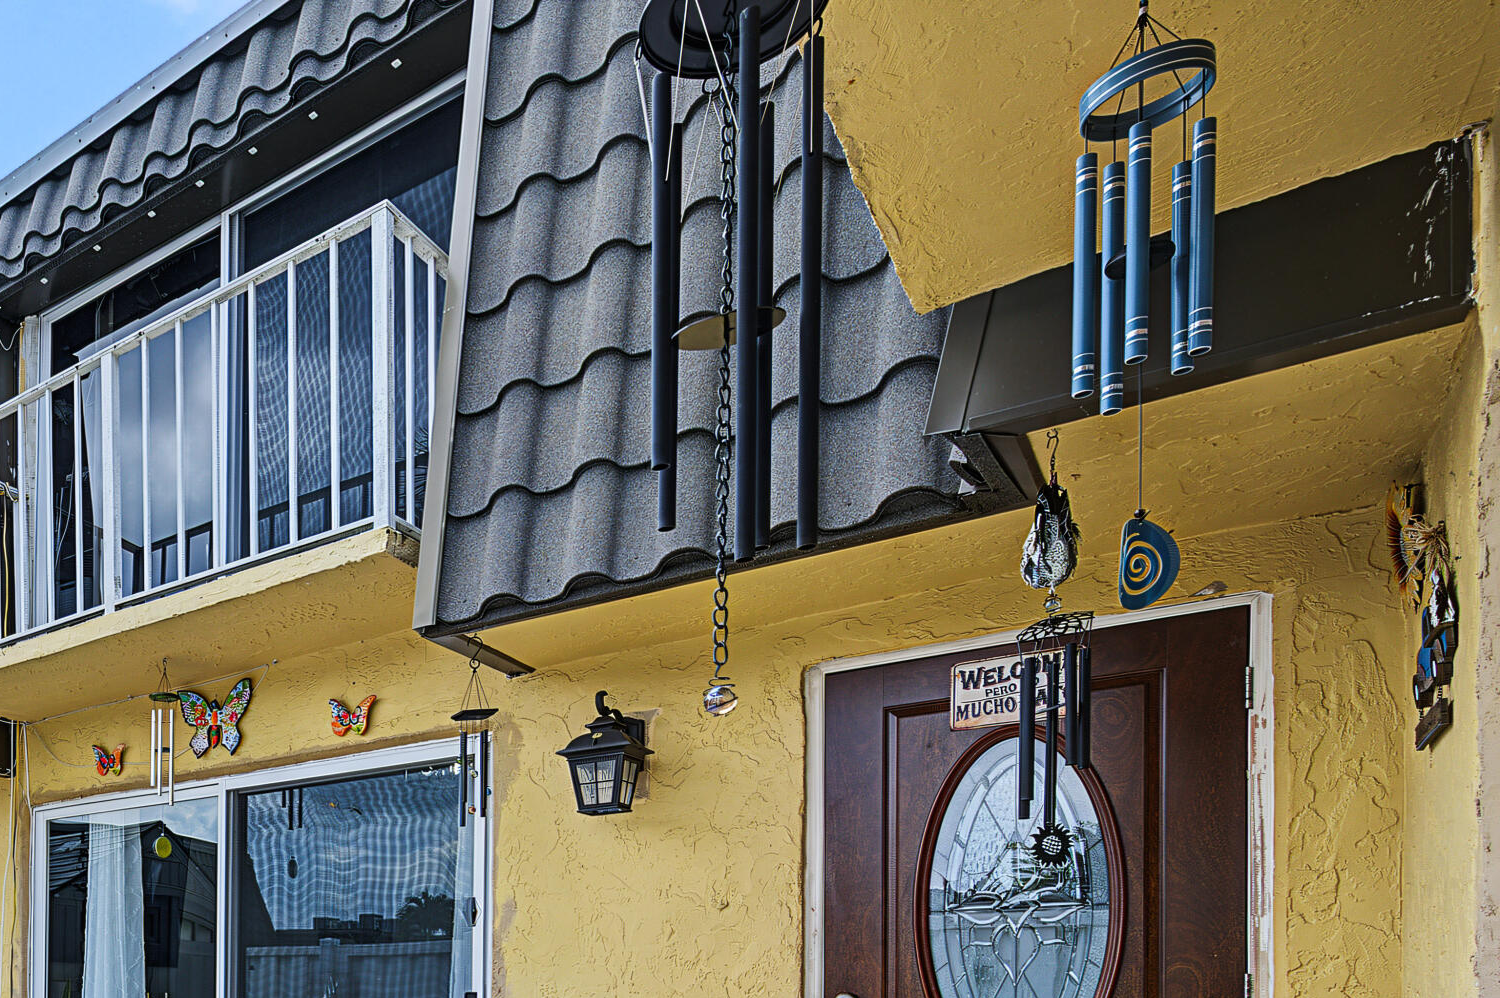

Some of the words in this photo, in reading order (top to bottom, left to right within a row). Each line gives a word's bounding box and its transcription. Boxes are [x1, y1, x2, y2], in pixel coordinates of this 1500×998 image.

[958, 651, 1067, 690] WELCM
[985, 683, 1017, 697] PERO
[956, 697, 1017, 721] MUCHO
